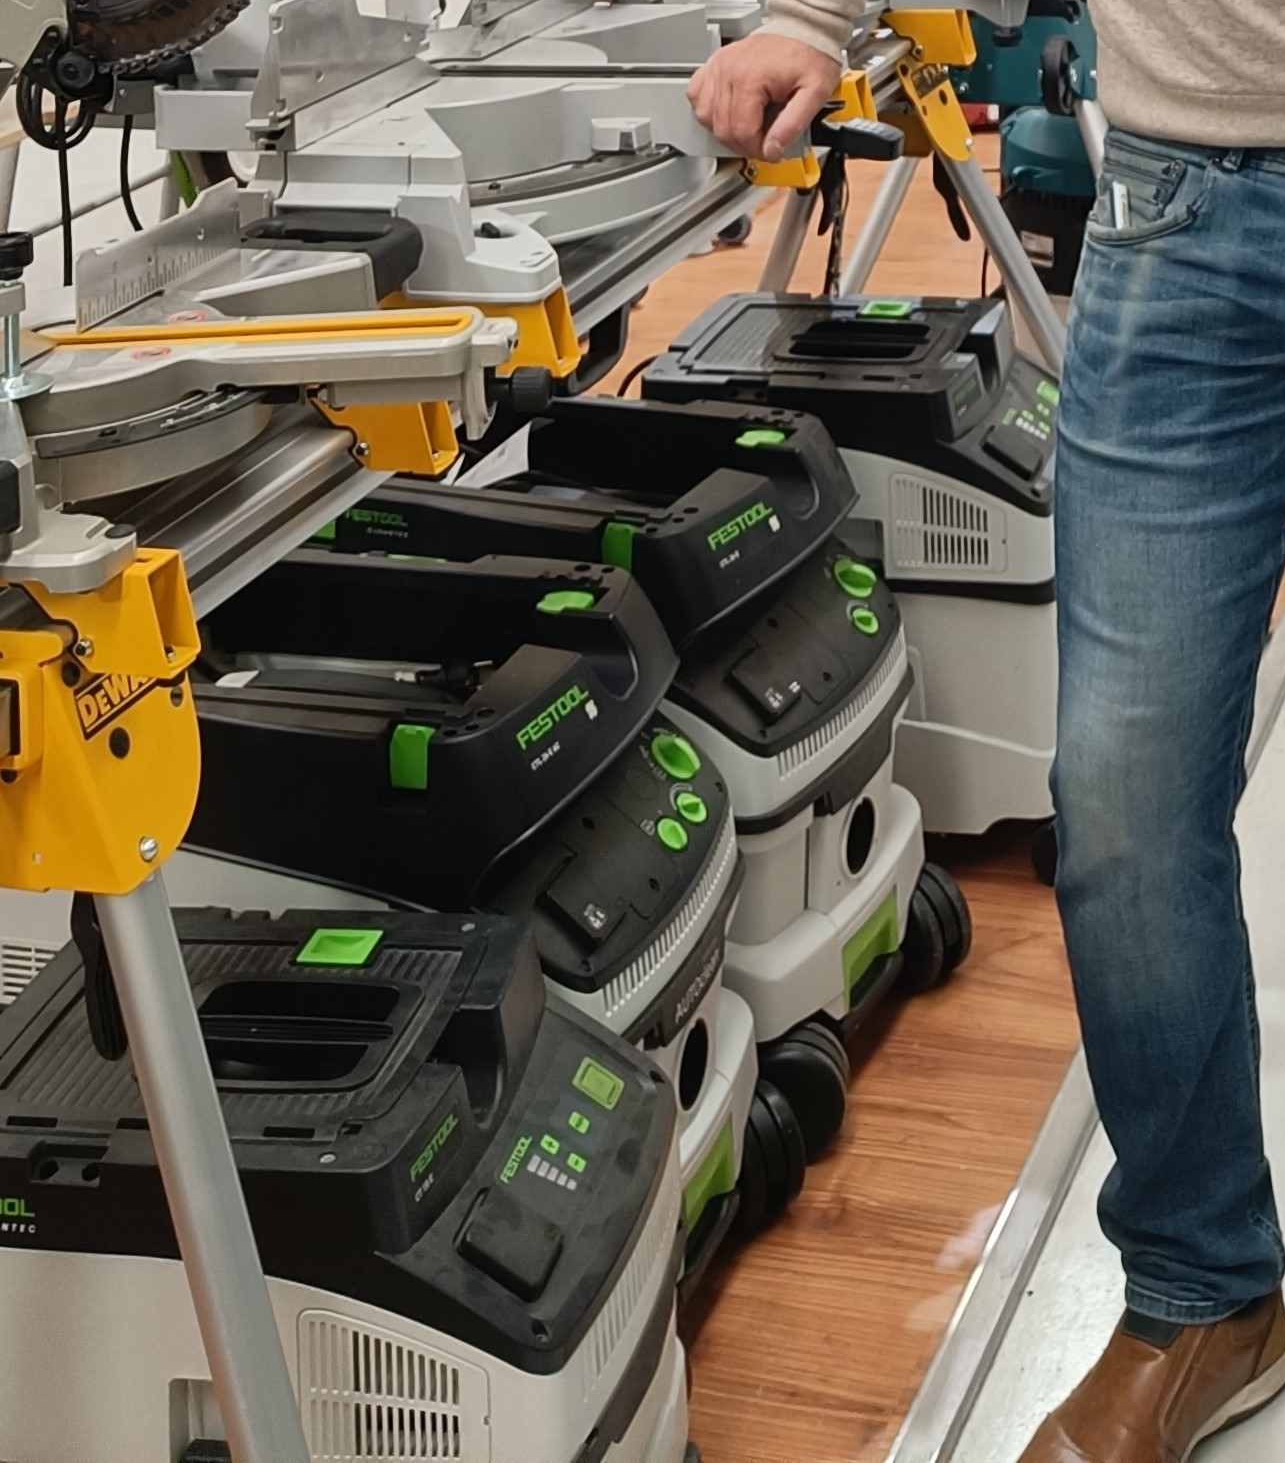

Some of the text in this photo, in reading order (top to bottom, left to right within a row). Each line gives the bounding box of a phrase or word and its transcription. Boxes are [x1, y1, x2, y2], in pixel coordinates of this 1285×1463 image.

[707, 501, 773, 551] FESTOOL
[515, 685, 589, 750] FESTOOL
[410, 1114, 459, 1183] FESTOOL
[499, 1136, 532, 1184] FESTOOL
